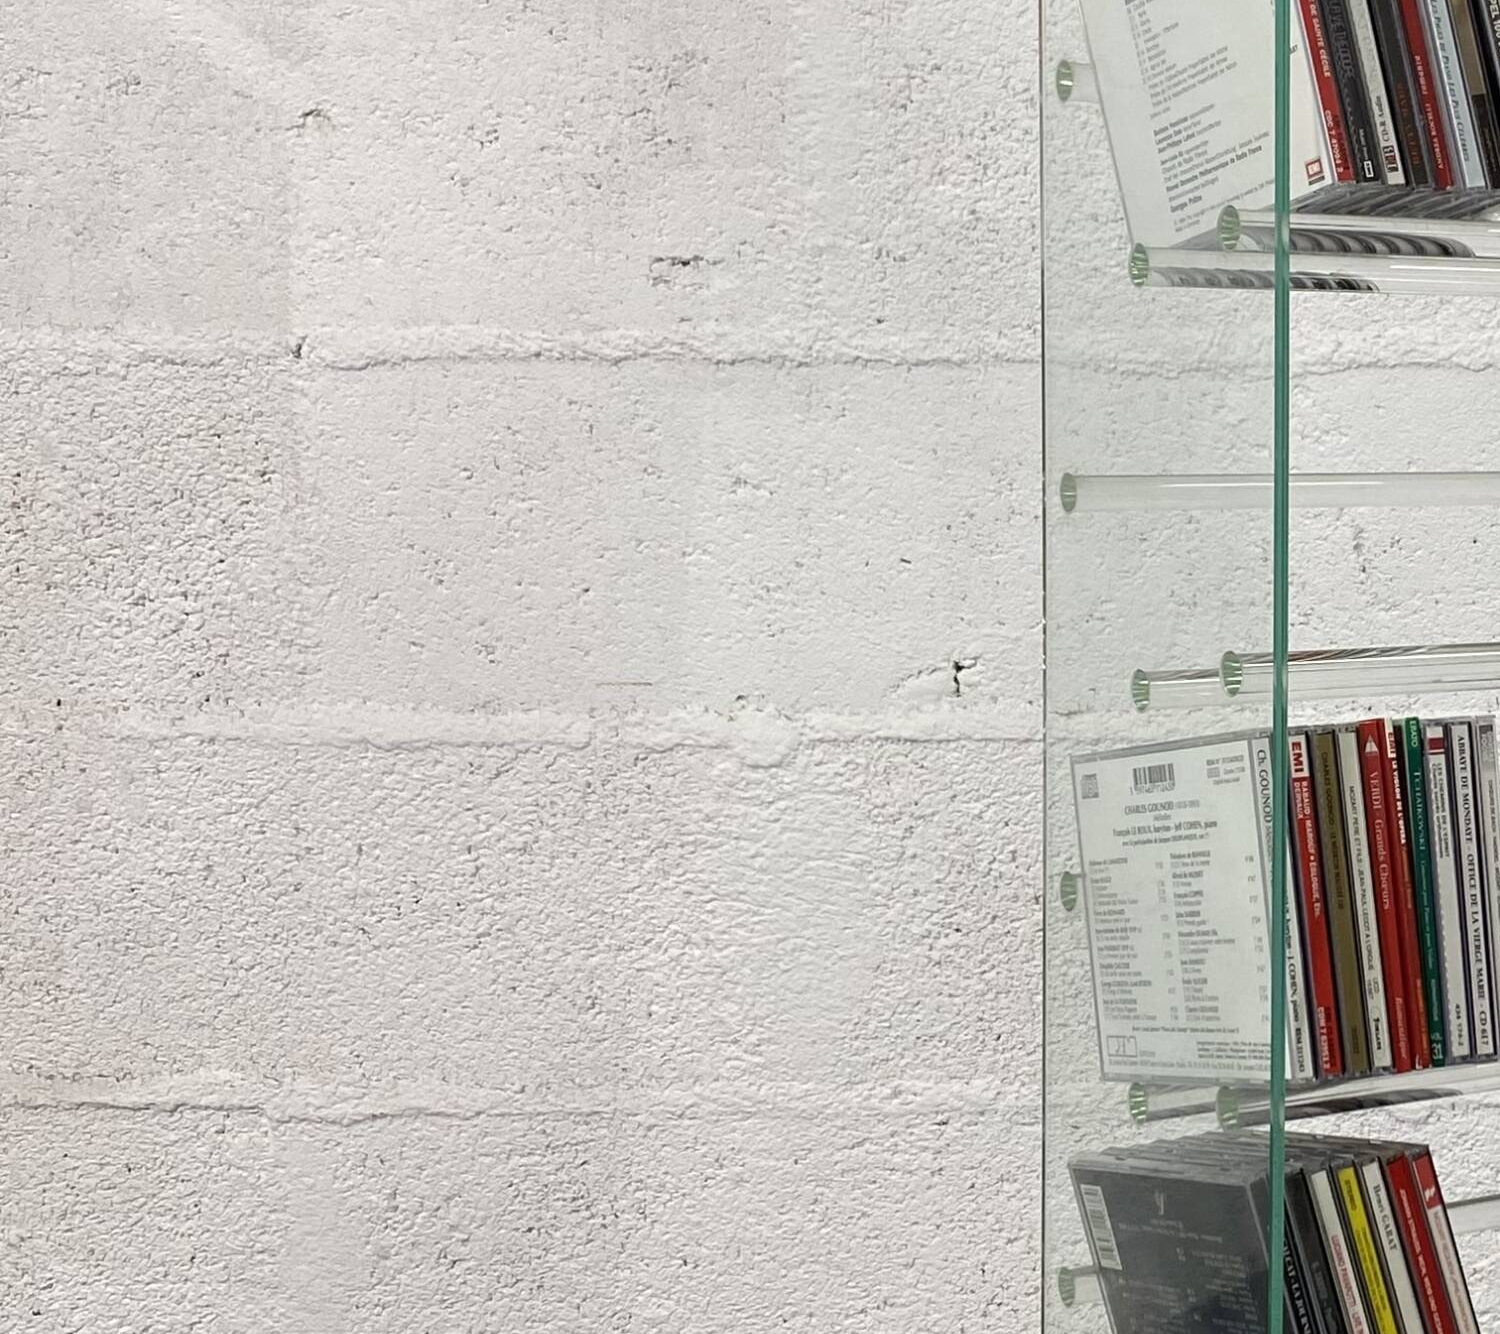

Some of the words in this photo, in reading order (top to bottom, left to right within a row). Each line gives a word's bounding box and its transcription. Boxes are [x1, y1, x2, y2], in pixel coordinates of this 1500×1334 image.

[1311, 17, 1324, 47] SAINTE
[1409, 720, 1418, 747] ERATO
[1256, 749, 1267, 766] Ch.
[1290, 741, 1304, 772] EMI
[1457, 735, 1467, 771] ABBAYE
[1257, 769, 1274, 823] GOUNOD
[1300, 781, 1310, 815] RABAUD
[1368, 771, 1381, 809] VERDI
[1392, 770, 1400, 799] VIOLON
[1396, 801, 1402, 810] DE
[1460, 776, 1469, 789] DE
[1293, 782, 1303, 819] DERVAUX
[1441, 815, 1447, 825] DE
[1461, 793, 1473, 842] MONDAYE
[1373, 819, 1387, 860] Grands
[1466, 853, 1476, 891] OFFICE
[1469, 894, 1478, 907] DE
[1470, 910, 1479, 923] LA
[1471, 927, 1482, 963] VIERGE
[1474, 968, 1485, 999] MARIE
[1478, 1010, 1487, 1025] CD
[1479, 1028, 1488, 1045] 617
[1344, 1178, 1357, 1211] STEREO
[1373, 1184, 1387, 1213] Henri
[1380, 1213, 1397, 1251] GARAT
[1291, 1283, 1302, 1299] LA
